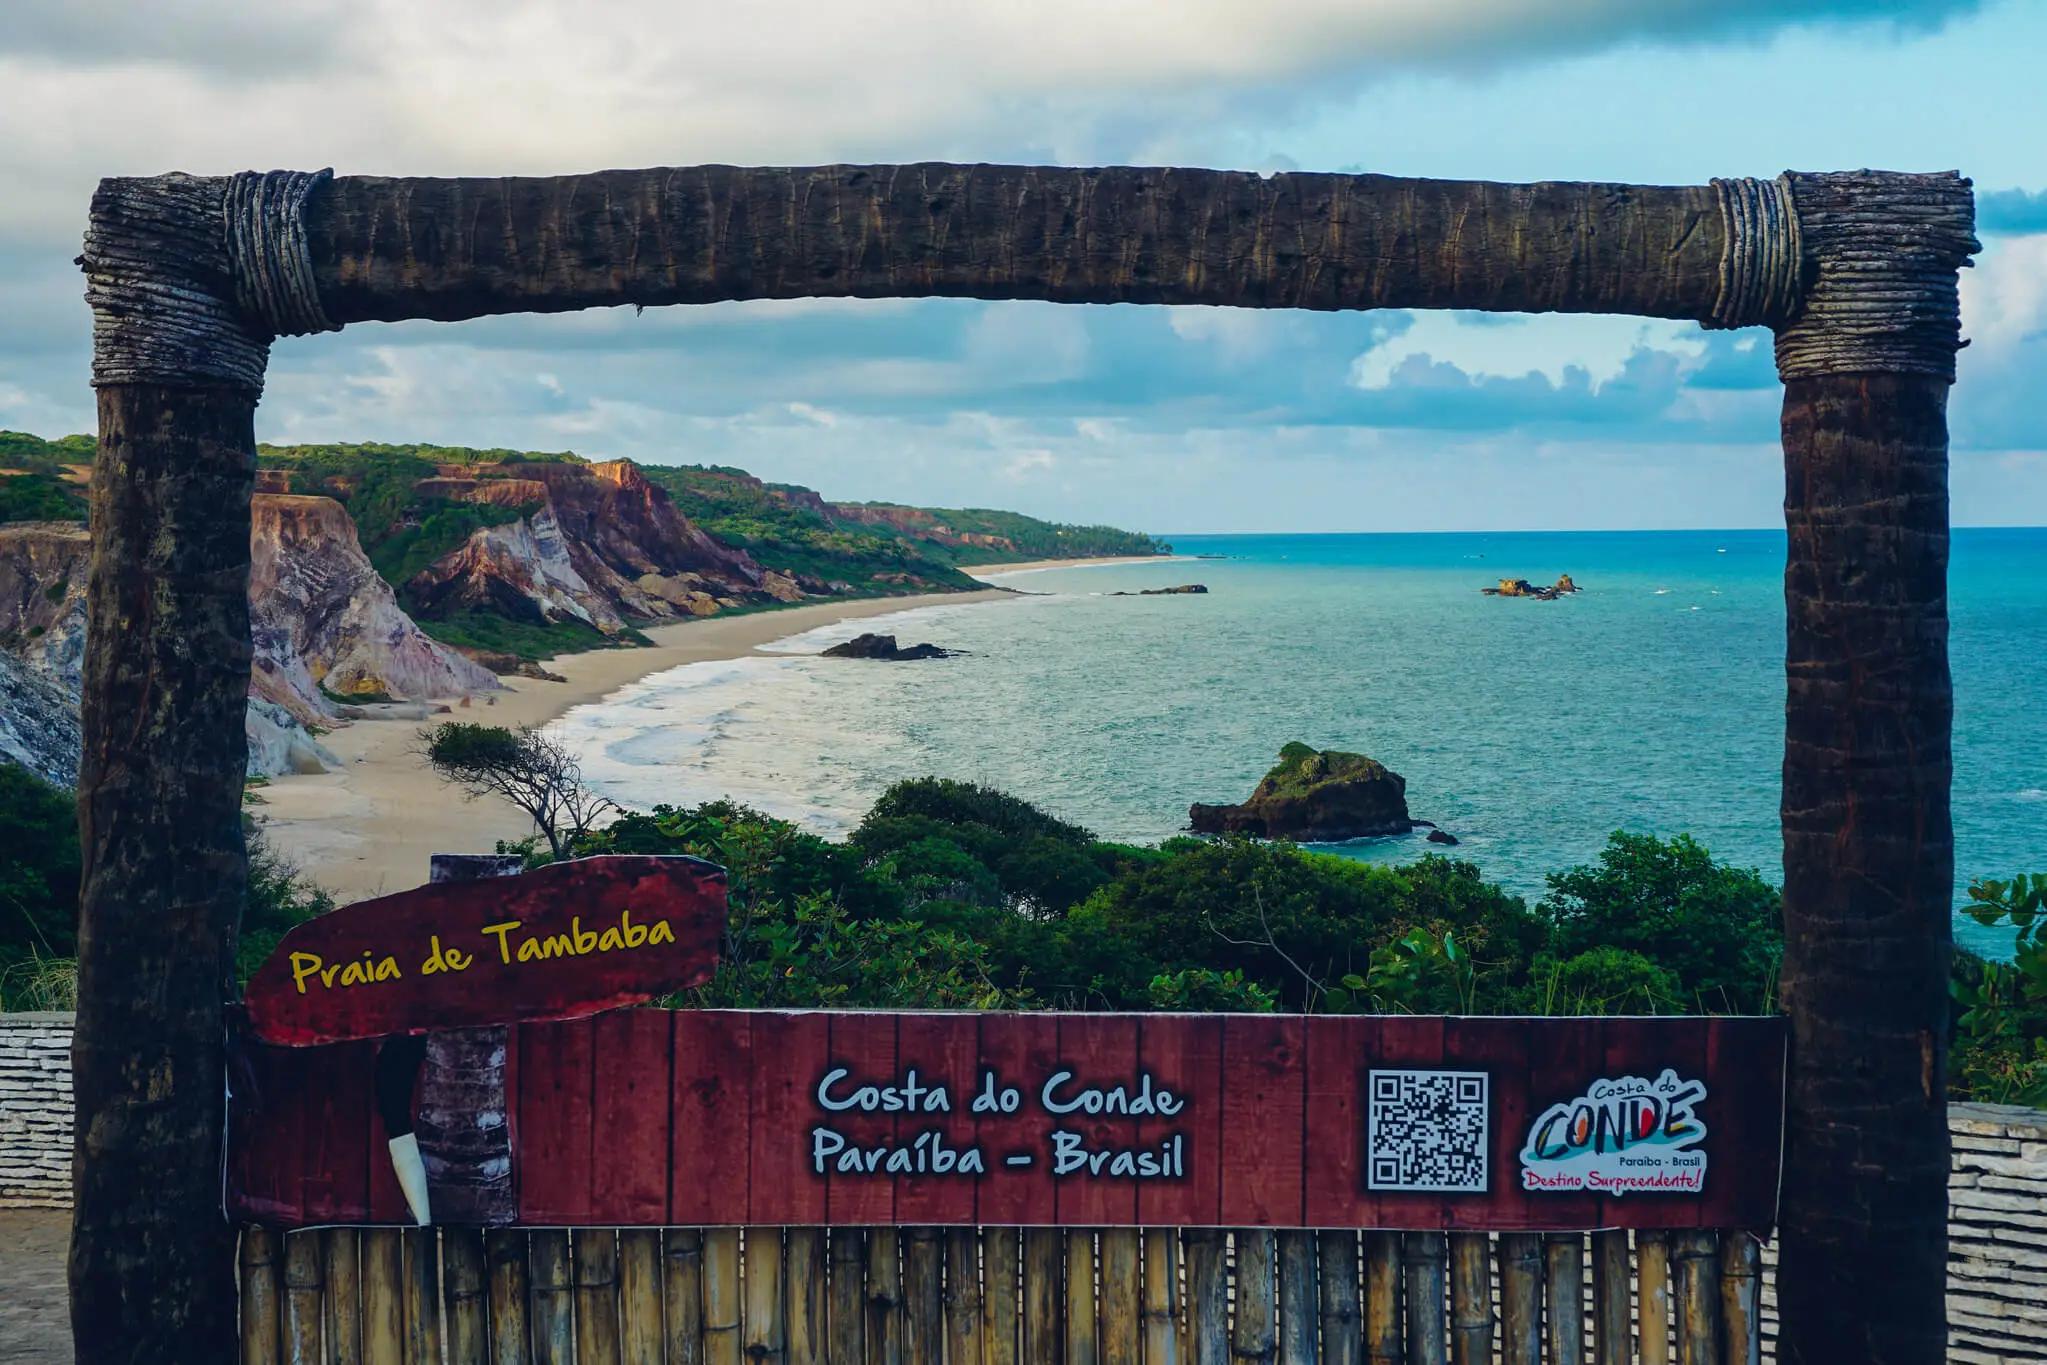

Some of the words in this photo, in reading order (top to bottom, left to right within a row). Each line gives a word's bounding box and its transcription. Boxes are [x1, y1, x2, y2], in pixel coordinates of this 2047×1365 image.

[289, 951, 401, 993] Praia
[421, 935, 473, 975] de
[482, 910, 674, 964] Tambaba
[818, 1069, 950, 1112] Costa
[972, 1072, 1019, 1113] do
[1042, 1072, 1183, 1115] Conde
[1595, 1083, 1645, 1099] Costa
[1659, 1076, 1675, 1092] do
[1536, 1088, 1699, 1159] CONDE
[813, 1128, 984, 1173] Paraíba
[1007, 1156, 1032, 1164] -
[1052, 1131, 1183, 1176] Brasil
[1672, 1157, 1700, 1166] Brasil
[1527, 1173, 1581, 1186] Destino
[1590, 1170, 1701, 1190] Surpreendente!
